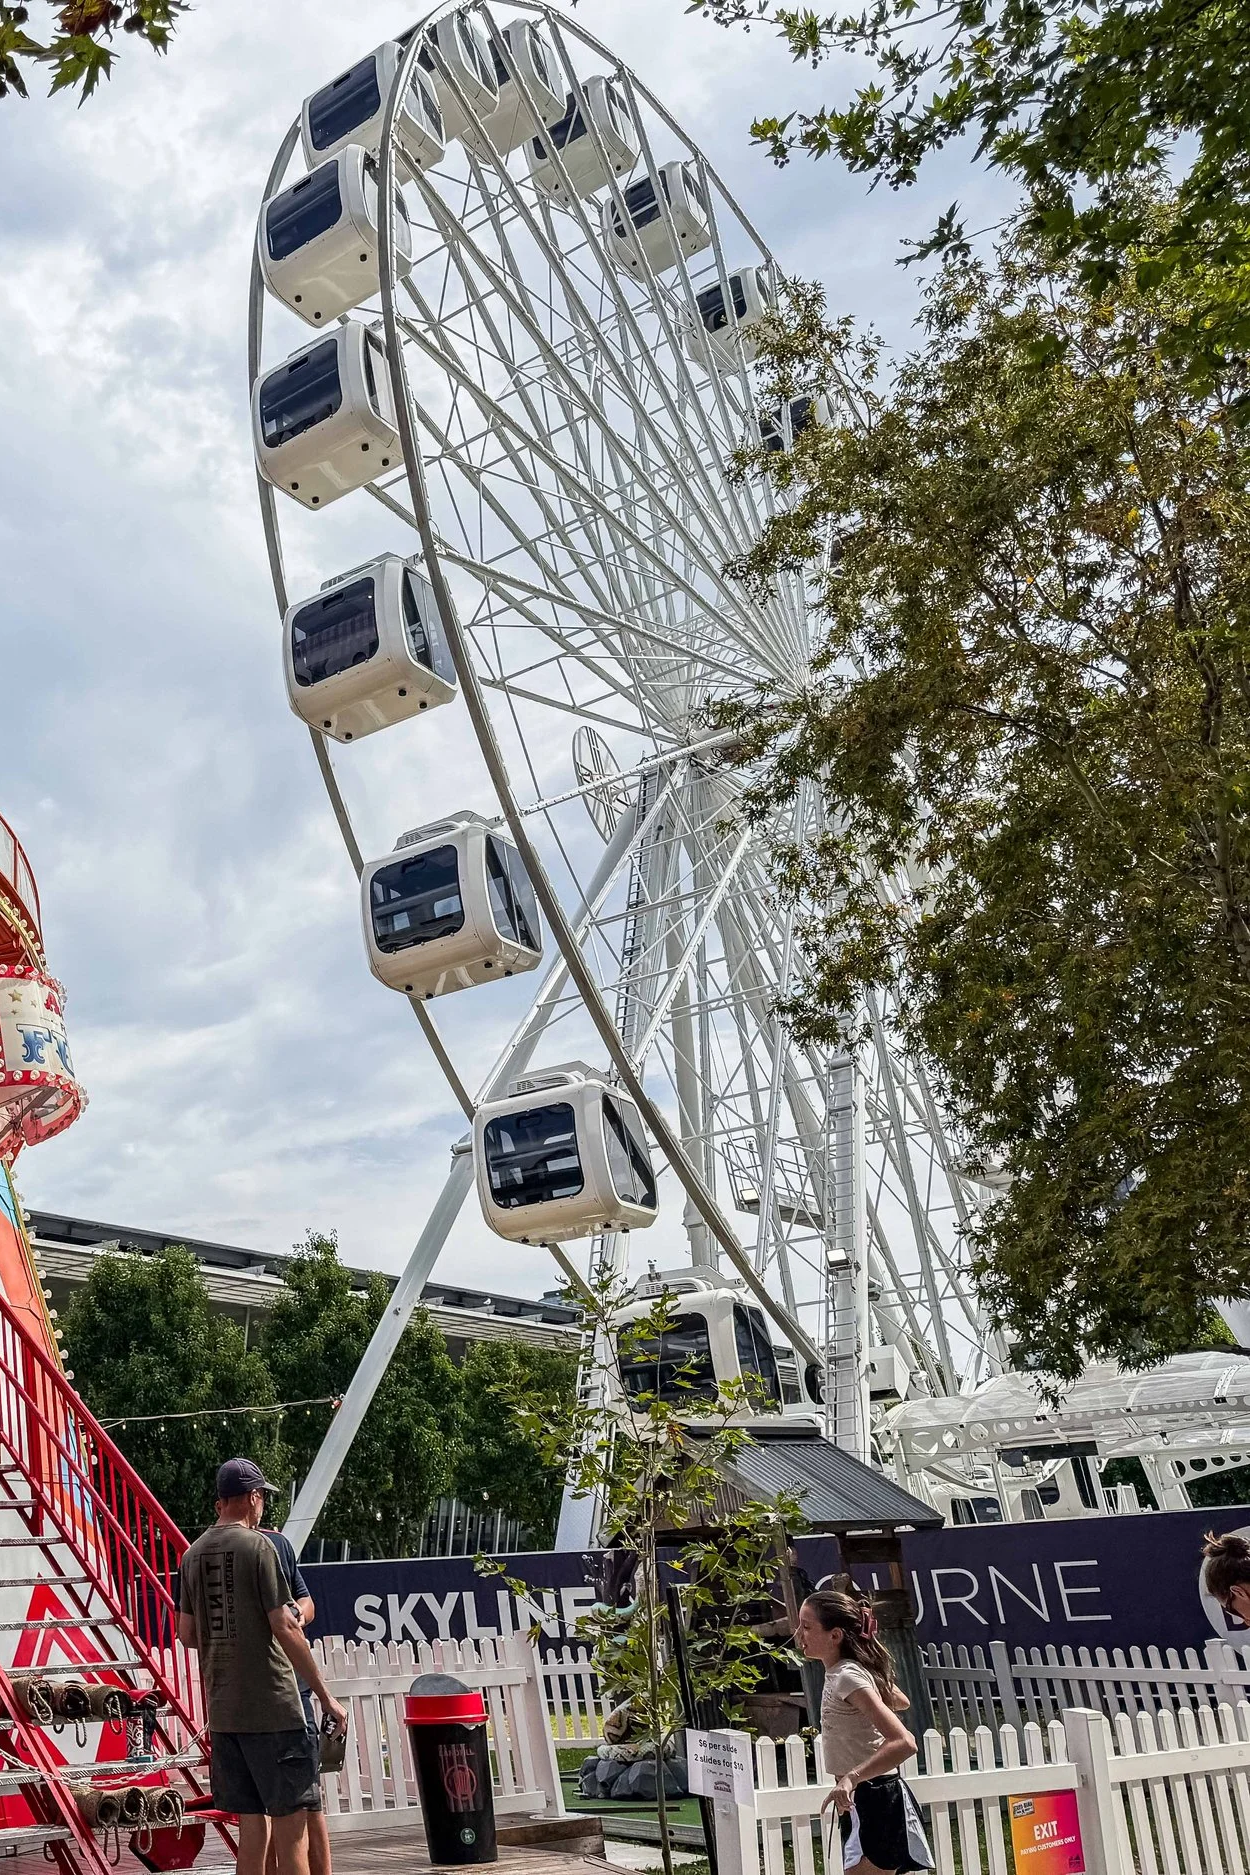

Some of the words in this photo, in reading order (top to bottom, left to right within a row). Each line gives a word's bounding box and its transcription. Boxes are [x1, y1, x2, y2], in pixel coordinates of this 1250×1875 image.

[206, 1562, 224, 1631] UNIT
[354, 1586, 596, 1642] SKYLINE
[699, 1739, 707, 1748] $6
[708, 1742, 721, 1751] per
[722, 1744, 737, 1753] slide
[700, 1755, 721, 1765] slides
[723, 1759, 732, 1767] for
[734, 1761, 743, 1771] $10
[1033, 1821, 1057, 1840] EXIT
[1020, 1846, 1037, 1854] PAYING
[1037, 1840, 1063, 1850] CUSTOMERS
[1064, 1836, 1075, 1844] ONLY
